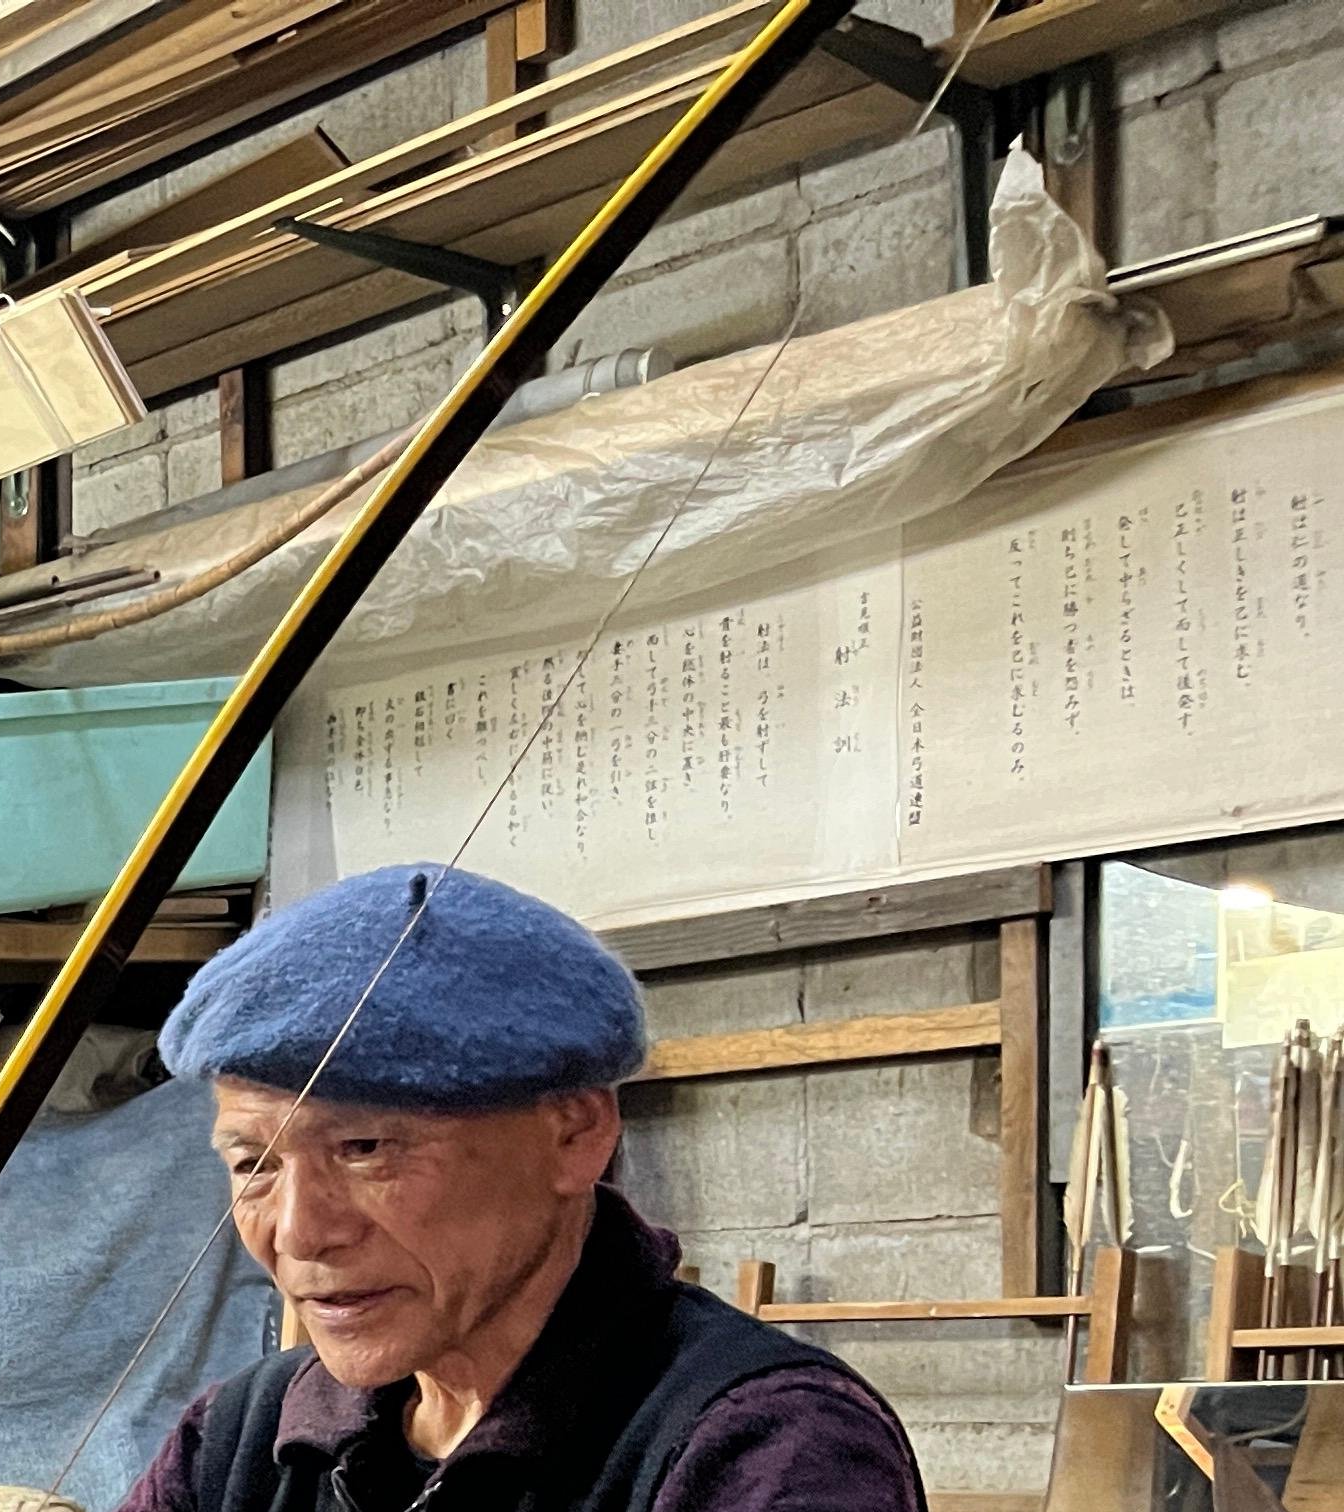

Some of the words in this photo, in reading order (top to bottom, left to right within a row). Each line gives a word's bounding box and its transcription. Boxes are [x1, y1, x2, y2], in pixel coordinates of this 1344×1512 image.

[910, 599, 924, 689] 公益財団法人
[908, 701, 925, 827] 全日本弓道連盟
